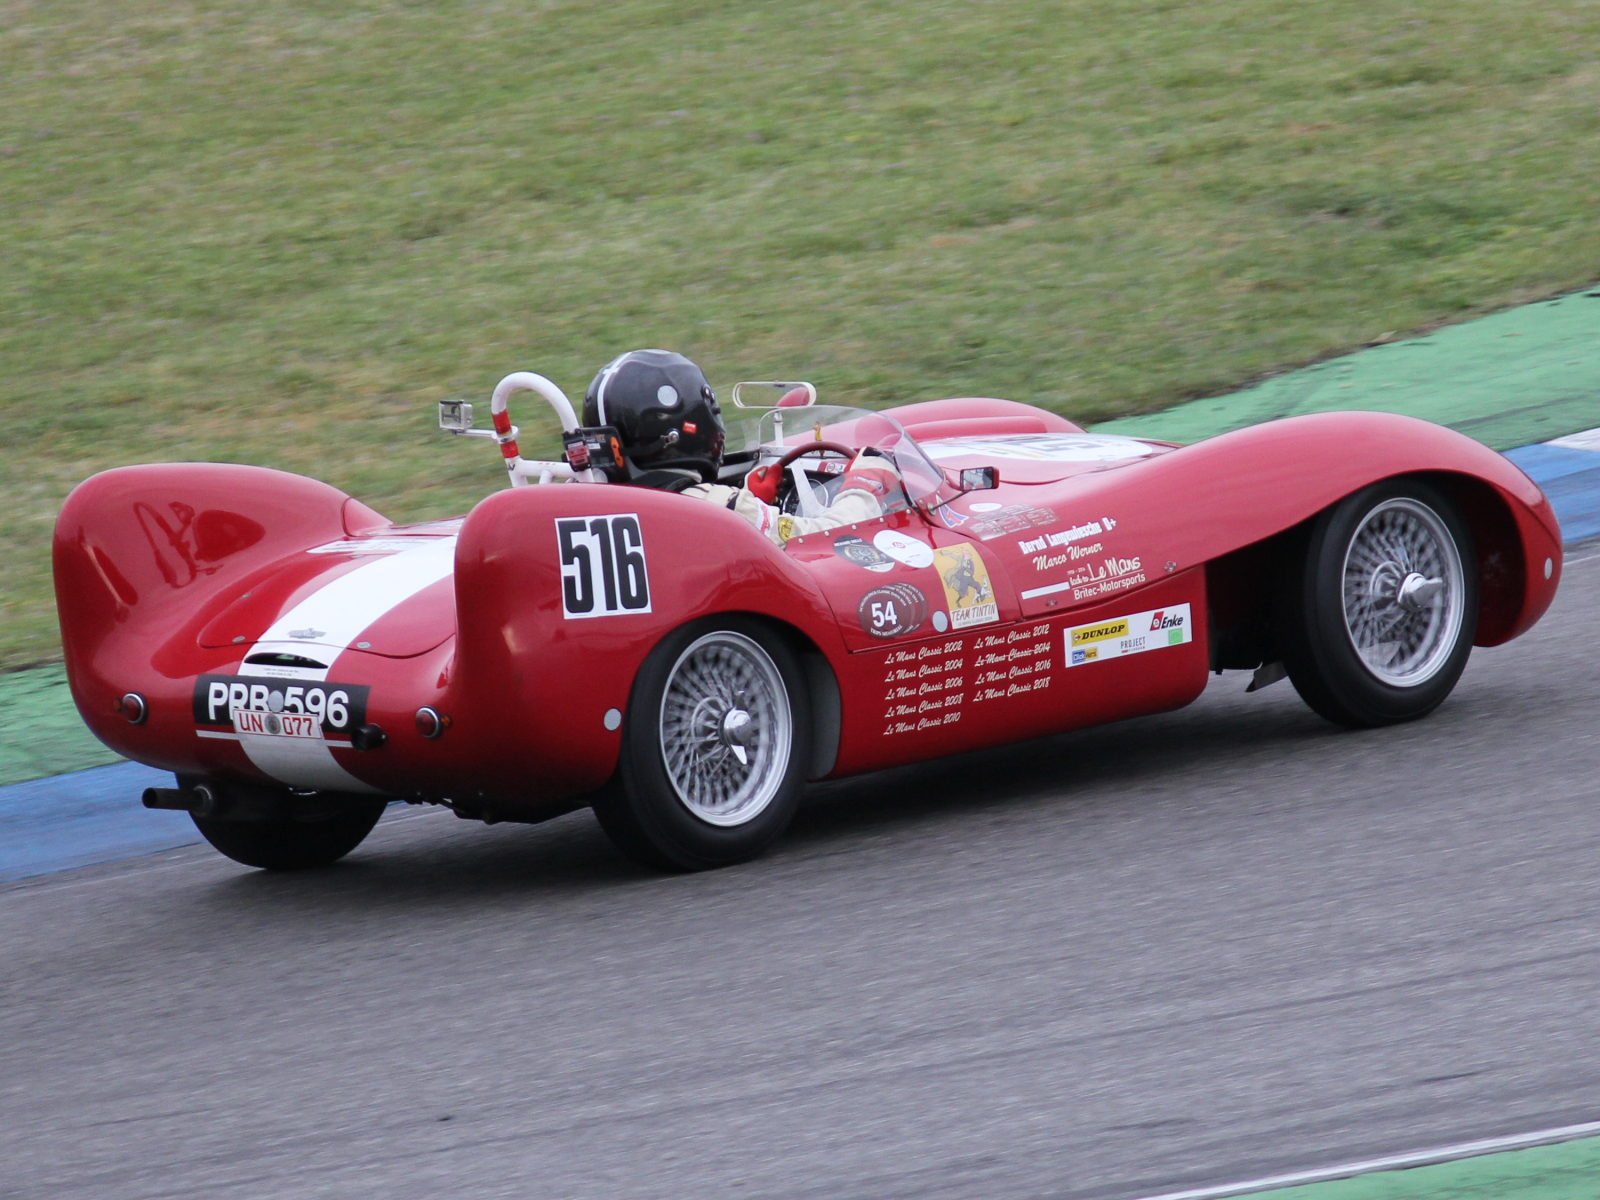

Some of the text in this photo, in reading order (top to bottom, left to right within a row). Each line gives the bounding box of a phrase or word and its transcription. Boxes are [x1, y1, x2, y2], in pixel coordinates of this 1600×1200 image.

[1018, 536, 1047, 554] Bernd
[1032, 543, 1103, 571] Marco Werner
[558, 516, 648, 613] 516
[1087, 563, 1107, 581] Le
[1105, 557, 1141, 576] Mans
[1074, 573, 1146, 600] Britec-Motorsports
[871, 600, 898, 628] 54
[952, 603, 996, 622] TEAM TINTIN
[1161, 614, 1183, 629] Enke
[974, 624, 1049, 649] Le Mans Classic 2012
[1082, 624, 1125, 640] DUNLOP
[1120, 636, 1146, 649] PROJECT
[884, 640, 963, 664] Le Mans Classic 2002
[974, 656, 985, 667] Le
[985, 654, 1006, 664] Mans
[1008, 648, 1032, 661] Classic
[885, 658, 963, 682] Le Mans Classic 2004
[974, 660, 1051, 684] Le Mans Classic 2016
[885, 677, 963, 700] Le Mans Classic 2006
[973, 691, 983, 702] Le
[985, 689, 1005, 699] Mans
[1007, 684, 1031, 696] Classic
[284, 686, 349, 728] 596
[885, 693, 964, 718] Le Mans Classic 2008
[239, 712, 264, 733] UN
[884, 712, 961, 735] Le Mans Classic 2010
